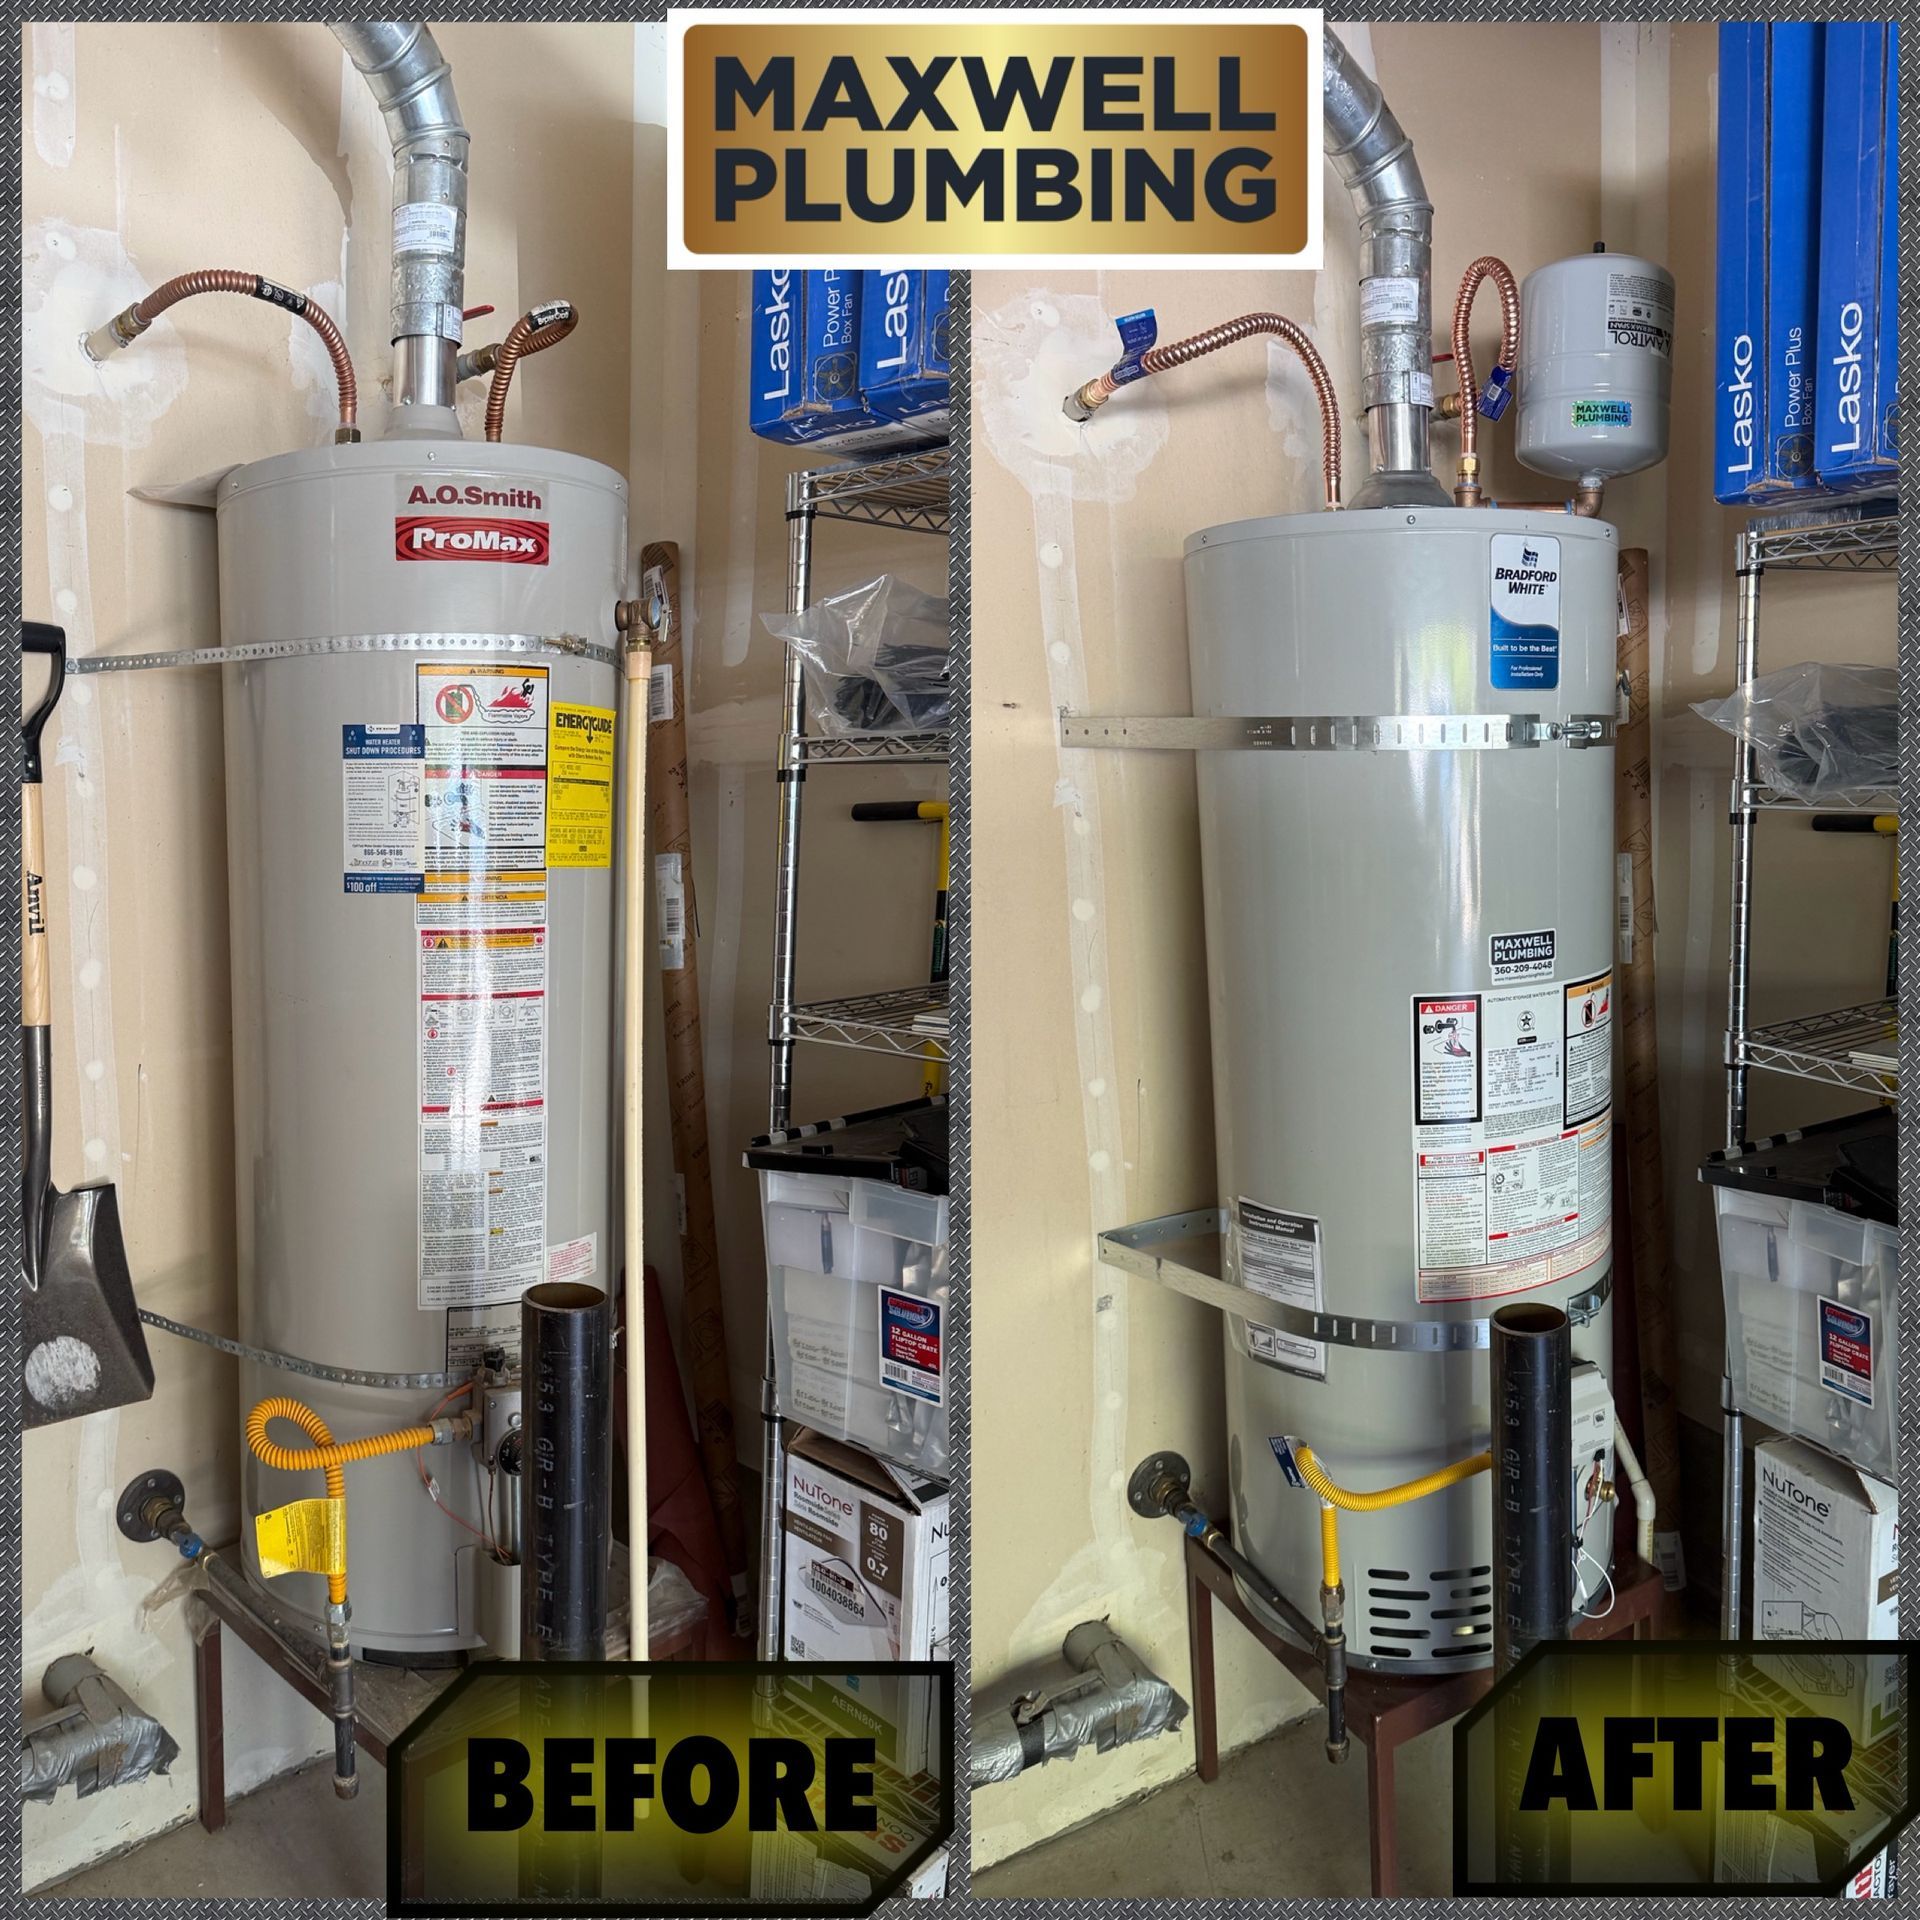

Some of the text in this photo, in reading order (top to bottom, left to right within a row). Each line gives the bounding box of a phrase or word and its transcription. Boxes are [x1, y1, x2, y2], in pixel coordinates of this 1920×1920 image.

[823, 287, 840, 348] Power
[841, 294, 853, 344] Box Fan
[876, 270, 908, 369] Las
[1784, 327, 1802, 428] Power Plus
[1832, 304, 1863, 452] Lasko
[1576, 405, 1628, 414] MAXWELL
[1728, 337, 1753, 473] Lasko
[1802, 378, 1812, 426] Box Fan
[1576, 414, 1629, 423] PLUMBING
[408, 485, 541, 510] A.O.Smith
[412, 527, 535, 553] ProMax
[1495, 567, 1557, 583] BRADFORD
[1508, 582, 1545, 595] WHITE
[1493, 644, 1509, 652] Built
[1510, 644, 1518, 652] to
[1519, 644, 1529, 652] be
[1530, 644, 1540, 652] the
[556, 712, 612, 734] ENERGYGUIDE
[346, 746, 421, 755] SHUT DOWN PROCEDURES
[346, 881, 364, 892] $100
[364, 882, 377, 892] off
[26, 870, 45, 936] Anvil
[1494, 934, 1553, 950] MAXWELL
[1494, 946, 1553, 962] PLUMBING
[1494, 960, 1553, 975] 360-209-4048
[1435, 1004, 1468, 1013] DANGER
[892, 1326, 927, 1344] 12 GALLON
[918, 1342, 938, 1354] CRATE
[793, 1474, 853, 1516] NuTone
[1763, 1467, 1830, 1517] NuTone
[869, 1522, 888, 1541] 80
[867, 1556, 889, 1577] 0.7
[1505, 1535, 1522, 1595] TYPE
[811, 1578, 865, 1618] 1004038864
[831, 1694, 883, 1736] AERN80K
